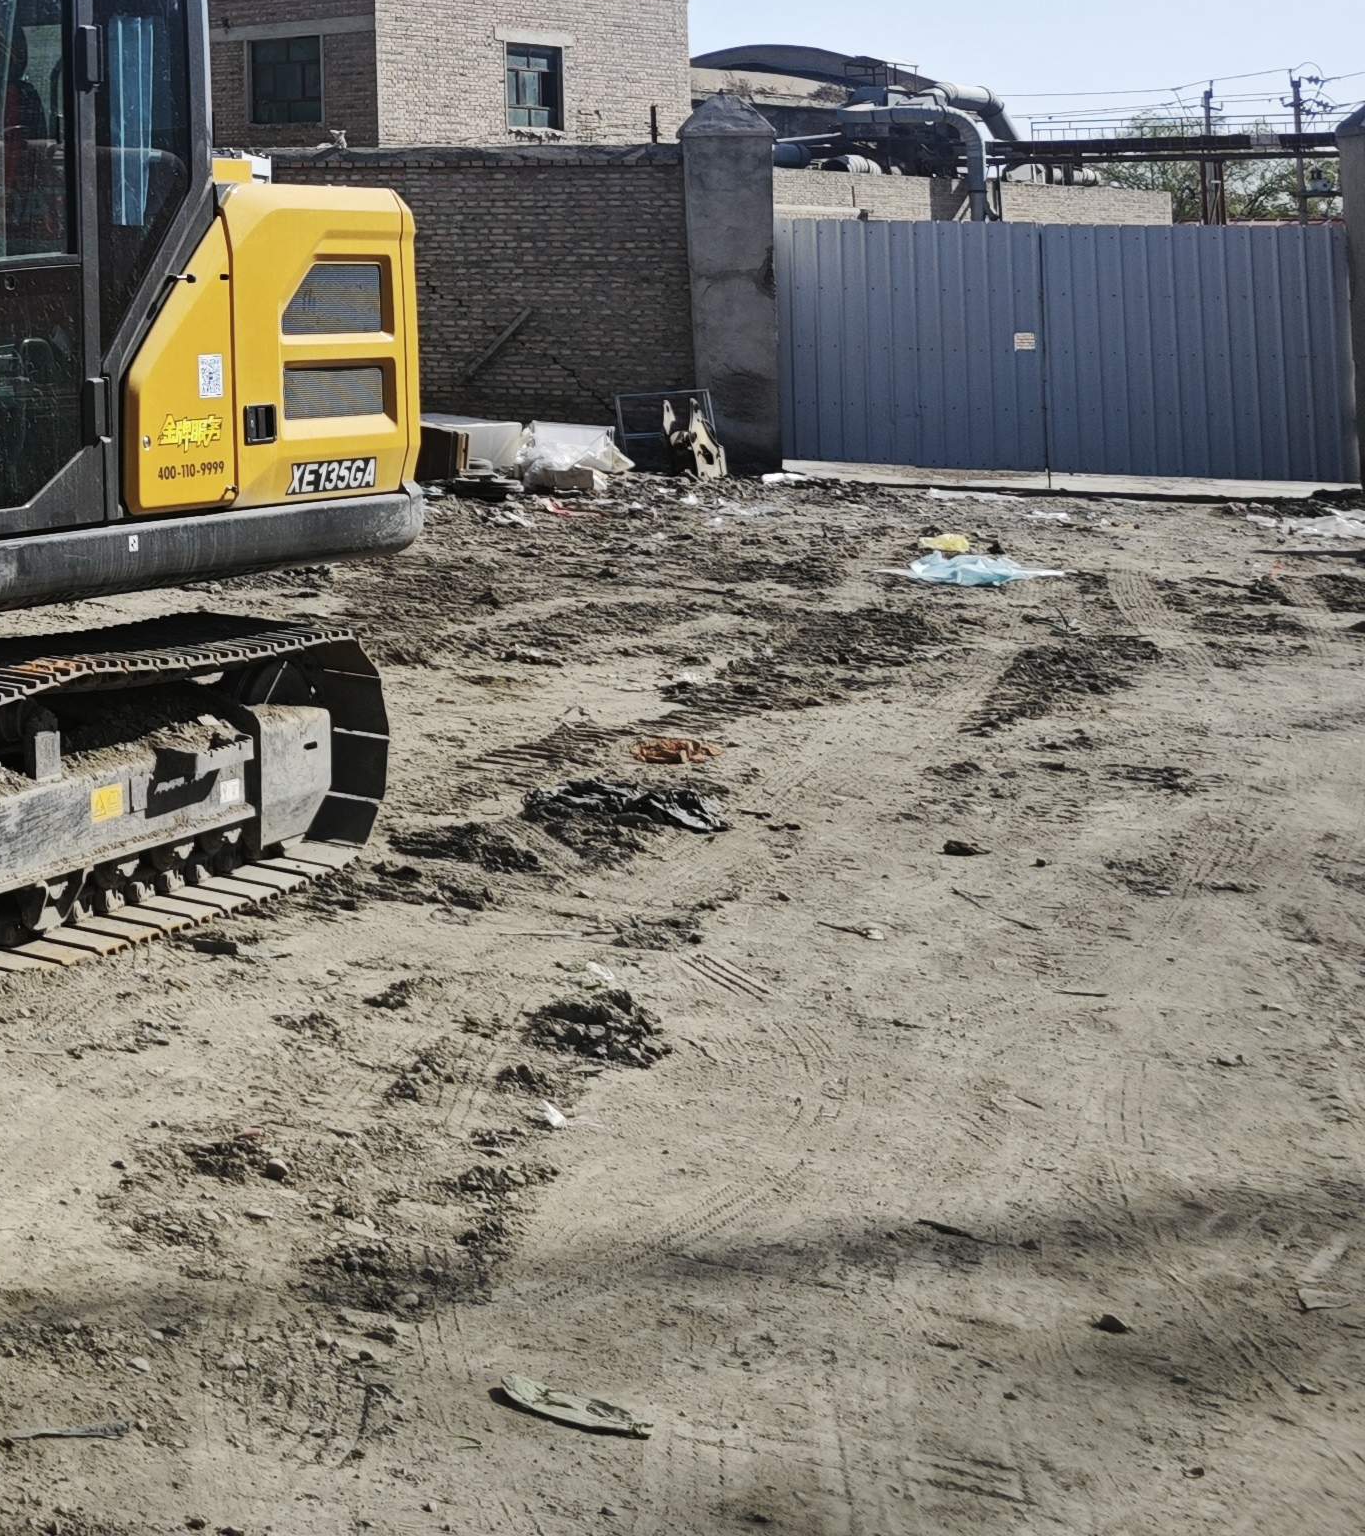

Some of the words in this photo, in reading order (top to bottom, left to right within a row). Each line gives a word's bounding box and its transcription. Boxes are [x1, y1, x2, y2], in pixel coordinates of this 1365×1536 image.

[157, 413, 223, 453] 金牌服务
[158, 461, 225, 480] 400-110-9999
[287, 458, 376, 494] XE135GA
